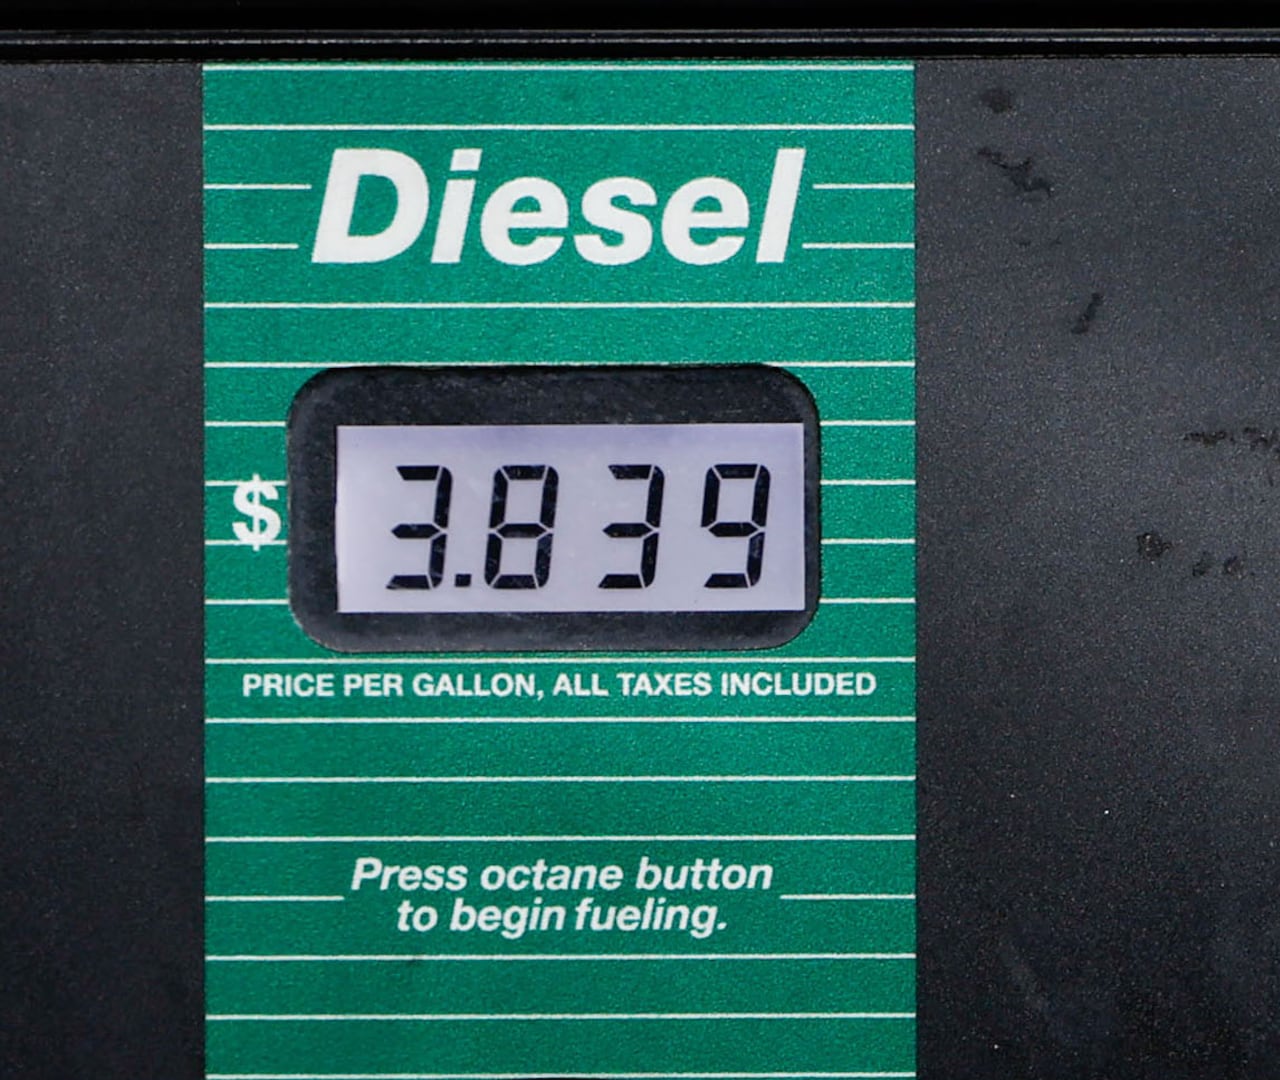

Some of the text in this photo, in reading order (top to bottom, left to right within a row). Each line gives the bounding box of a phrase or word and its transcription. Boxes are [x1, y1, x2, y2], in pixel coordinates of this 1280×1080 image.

[311, 148, 806, 265] Diesel
[232, 474, 282, 550] $
[385, 463, 771, 590] 3.839
[242, 672, 876, 701] PRICE PER GALLON, ALL TAXES INCLUDED
[351, 857, 773, 891] Press octane button
[397, 898, 726, 939] to begin fueling.
